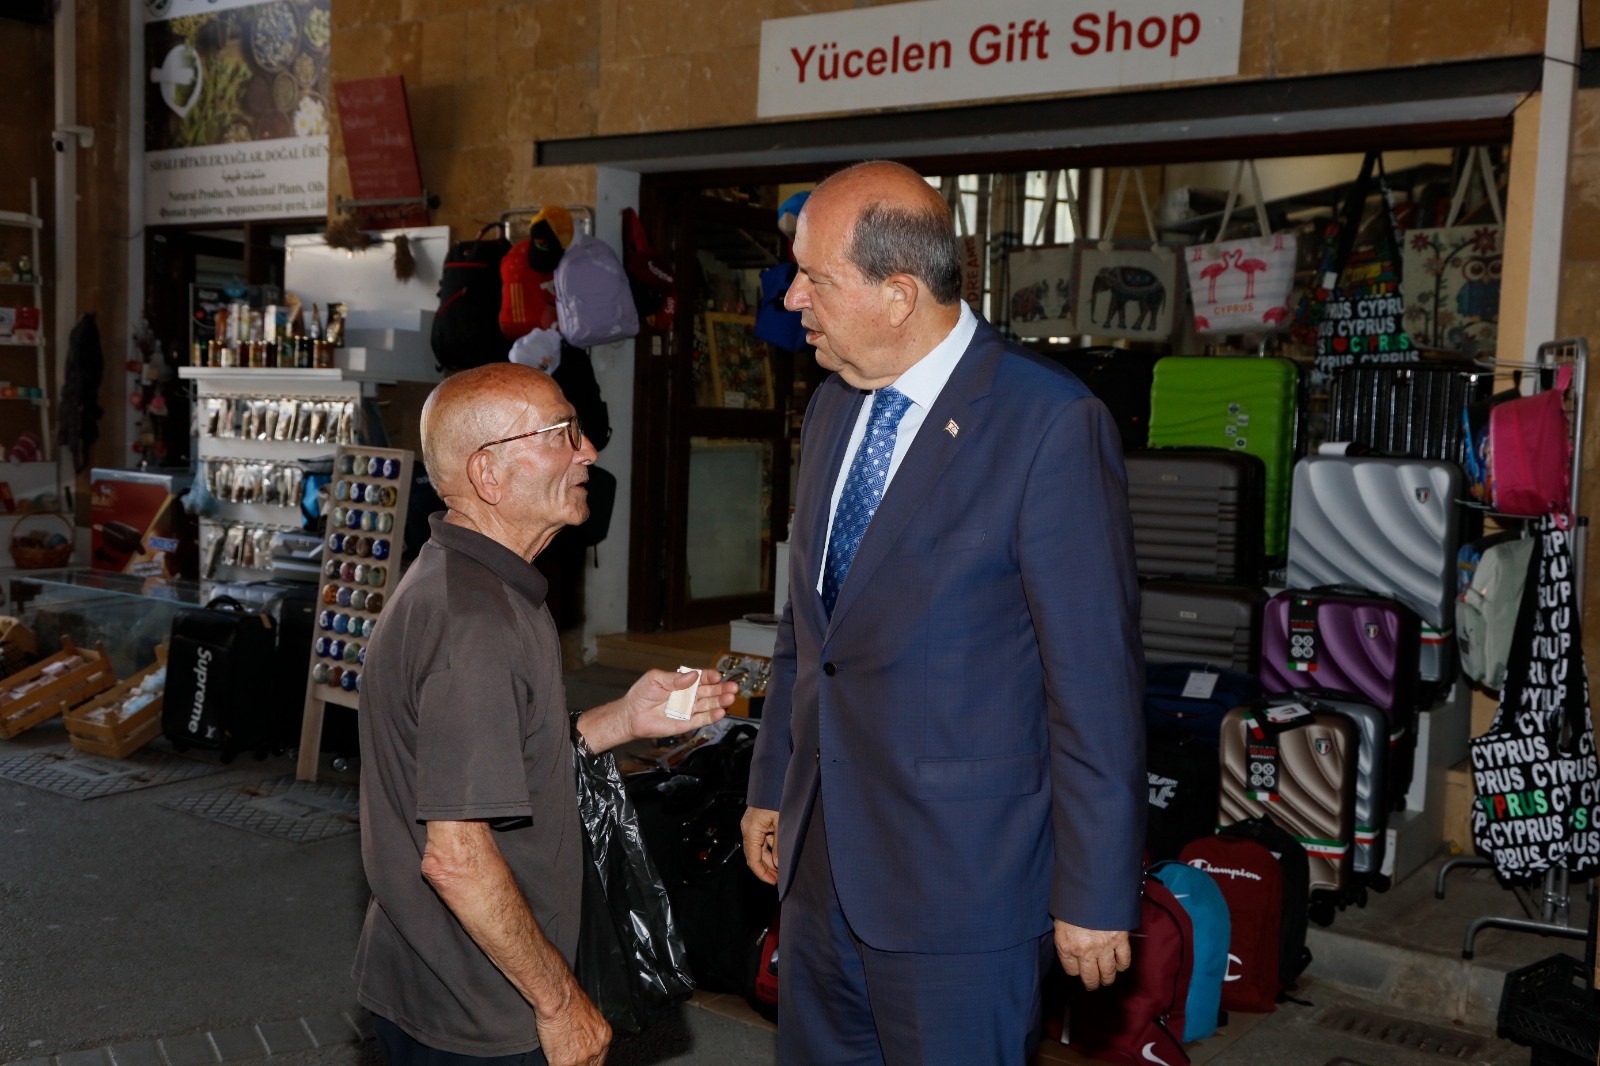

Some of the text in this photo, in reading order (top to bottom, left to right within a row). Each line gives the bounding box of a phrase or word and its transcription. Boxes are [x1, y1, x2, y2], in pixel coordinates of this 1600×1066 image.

[790, 10, 1202, 84] Yücelen Gift Shop
[168, 188, 197, 201] Natural
[236, 184, 276, 198] Medicinal
[1214, 303, 1254, 316] CYPRUS
[1337, 317, 1396, 337] CYPRUS
[188, 646, 213, 733] Supreme
[1471, 735, 1550, 769] CYPRUS
[1490, 814, 1564, 847] CYPRUS
